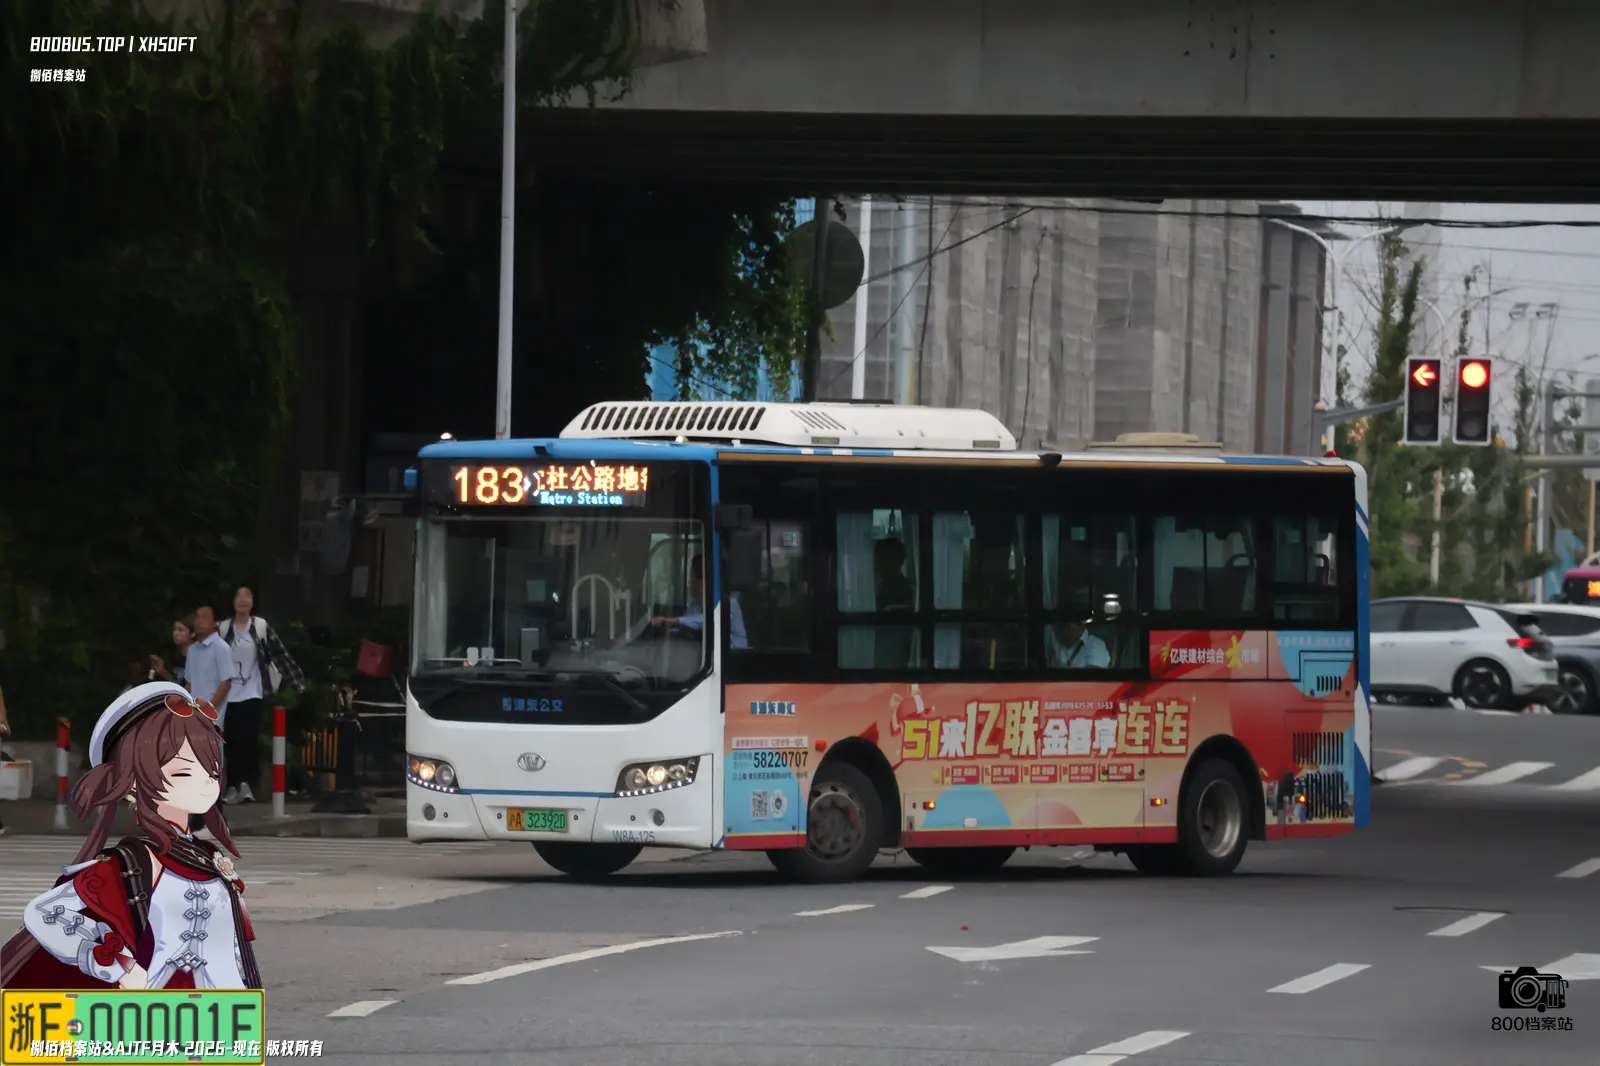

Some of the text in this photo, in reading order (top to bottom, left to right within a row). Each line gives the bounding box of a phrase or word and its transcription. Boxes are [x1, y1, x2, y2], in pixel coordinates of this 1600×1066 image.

[455, 467, 523, 503] 183
[540, 490, 623, 505] Metro Station
[753, 751, 808, 768] 58220707
[612, 830, 656, 843] W8A-125
